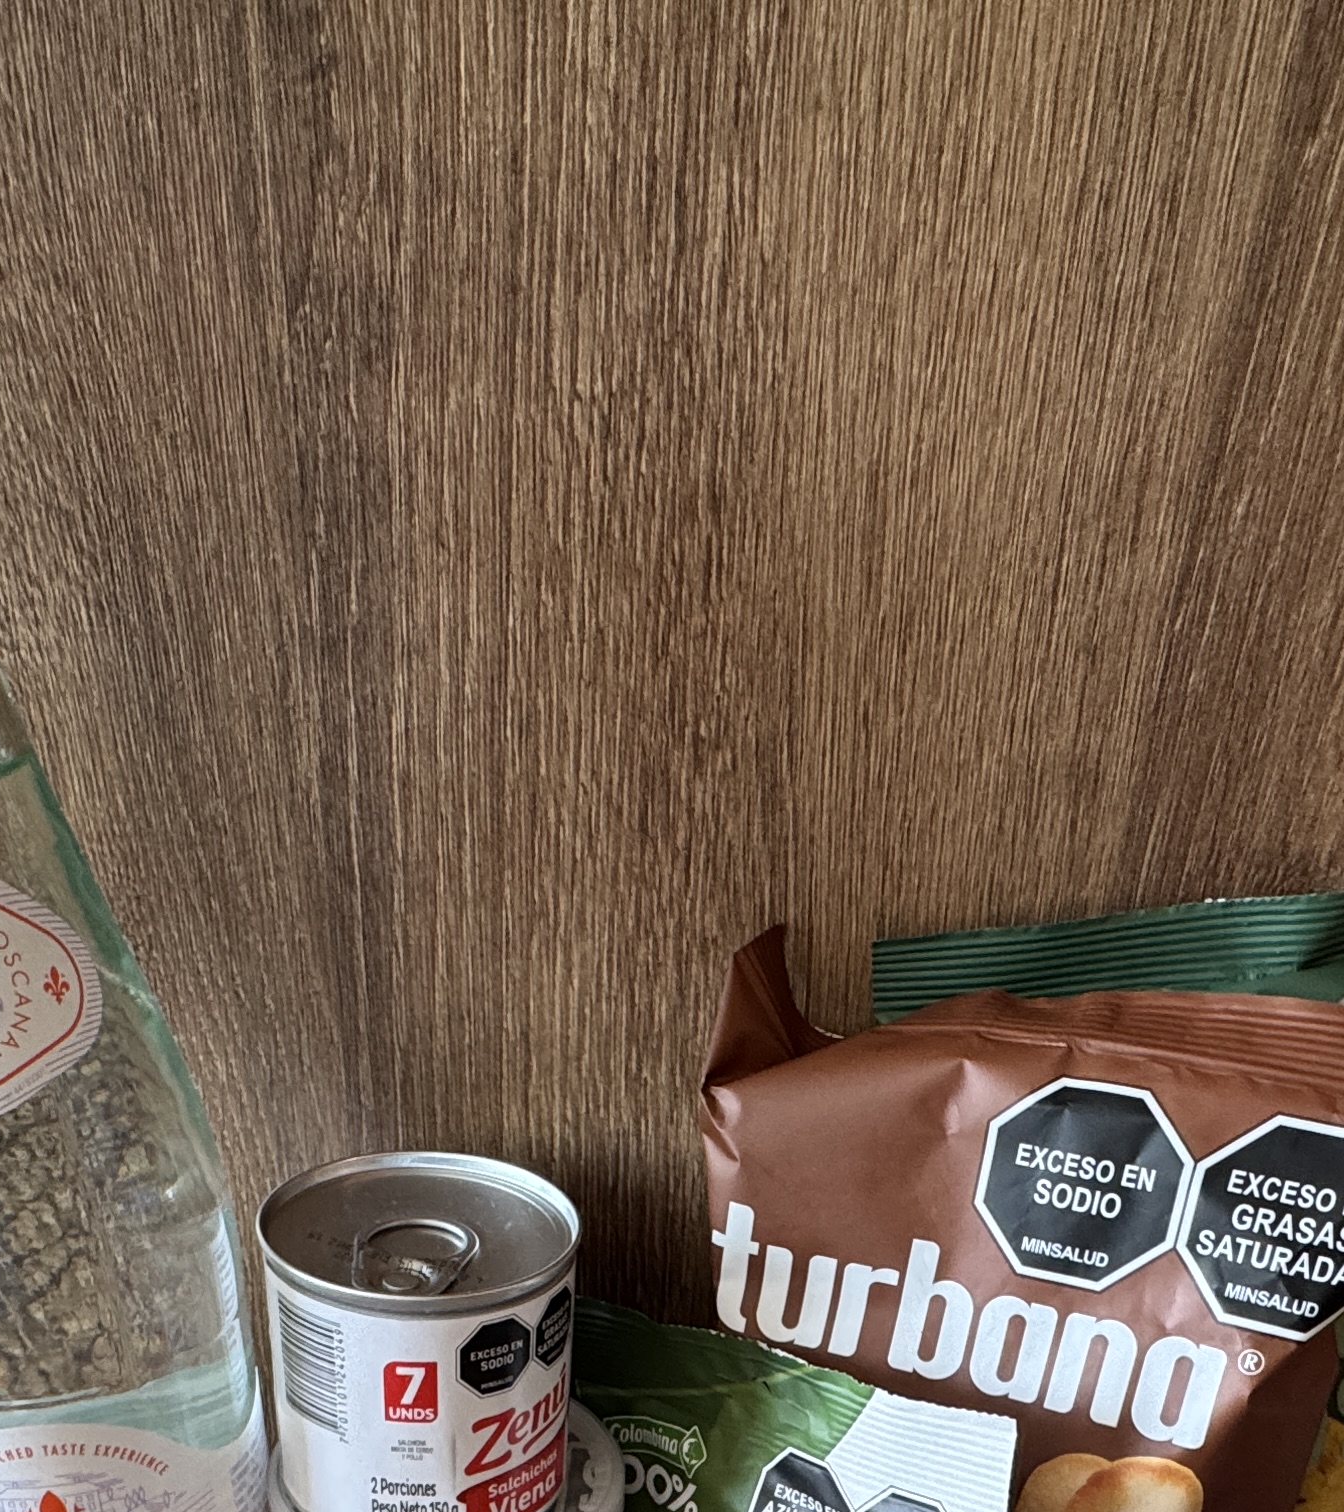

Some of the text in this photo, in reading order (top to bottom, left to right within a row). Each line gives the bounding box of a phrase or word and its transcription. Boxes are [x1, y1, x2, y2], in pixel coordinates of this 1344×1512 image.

[1015, 1142, 1157, 1194] EXCESO EN
[1033, 1177, 1123, 1220] SODIO
[1226, 1169, 1337, 1214] EXCESO
[1020, 1234, 1109, 1269] MINSALUD
[1224, 1282, 1320, 1319] MINSALUD
[711, 1200, 1228, 1450] turbana
[470, 1339, 523, 1361] EXCESO EN
[480, 1353, 514, 1371] SODIO
[396, 1367, 426, 1405] 7
[388, 1407, 435, 1421] UNDS
[609, 1423, 679, 1455] Colombina
[42, 1443, 169, 1476] TASTE EXPERIENCE
[488, 1450, 558, 1498] Salchichas
[371, 1477, 436, 1496] 2 Porciones
